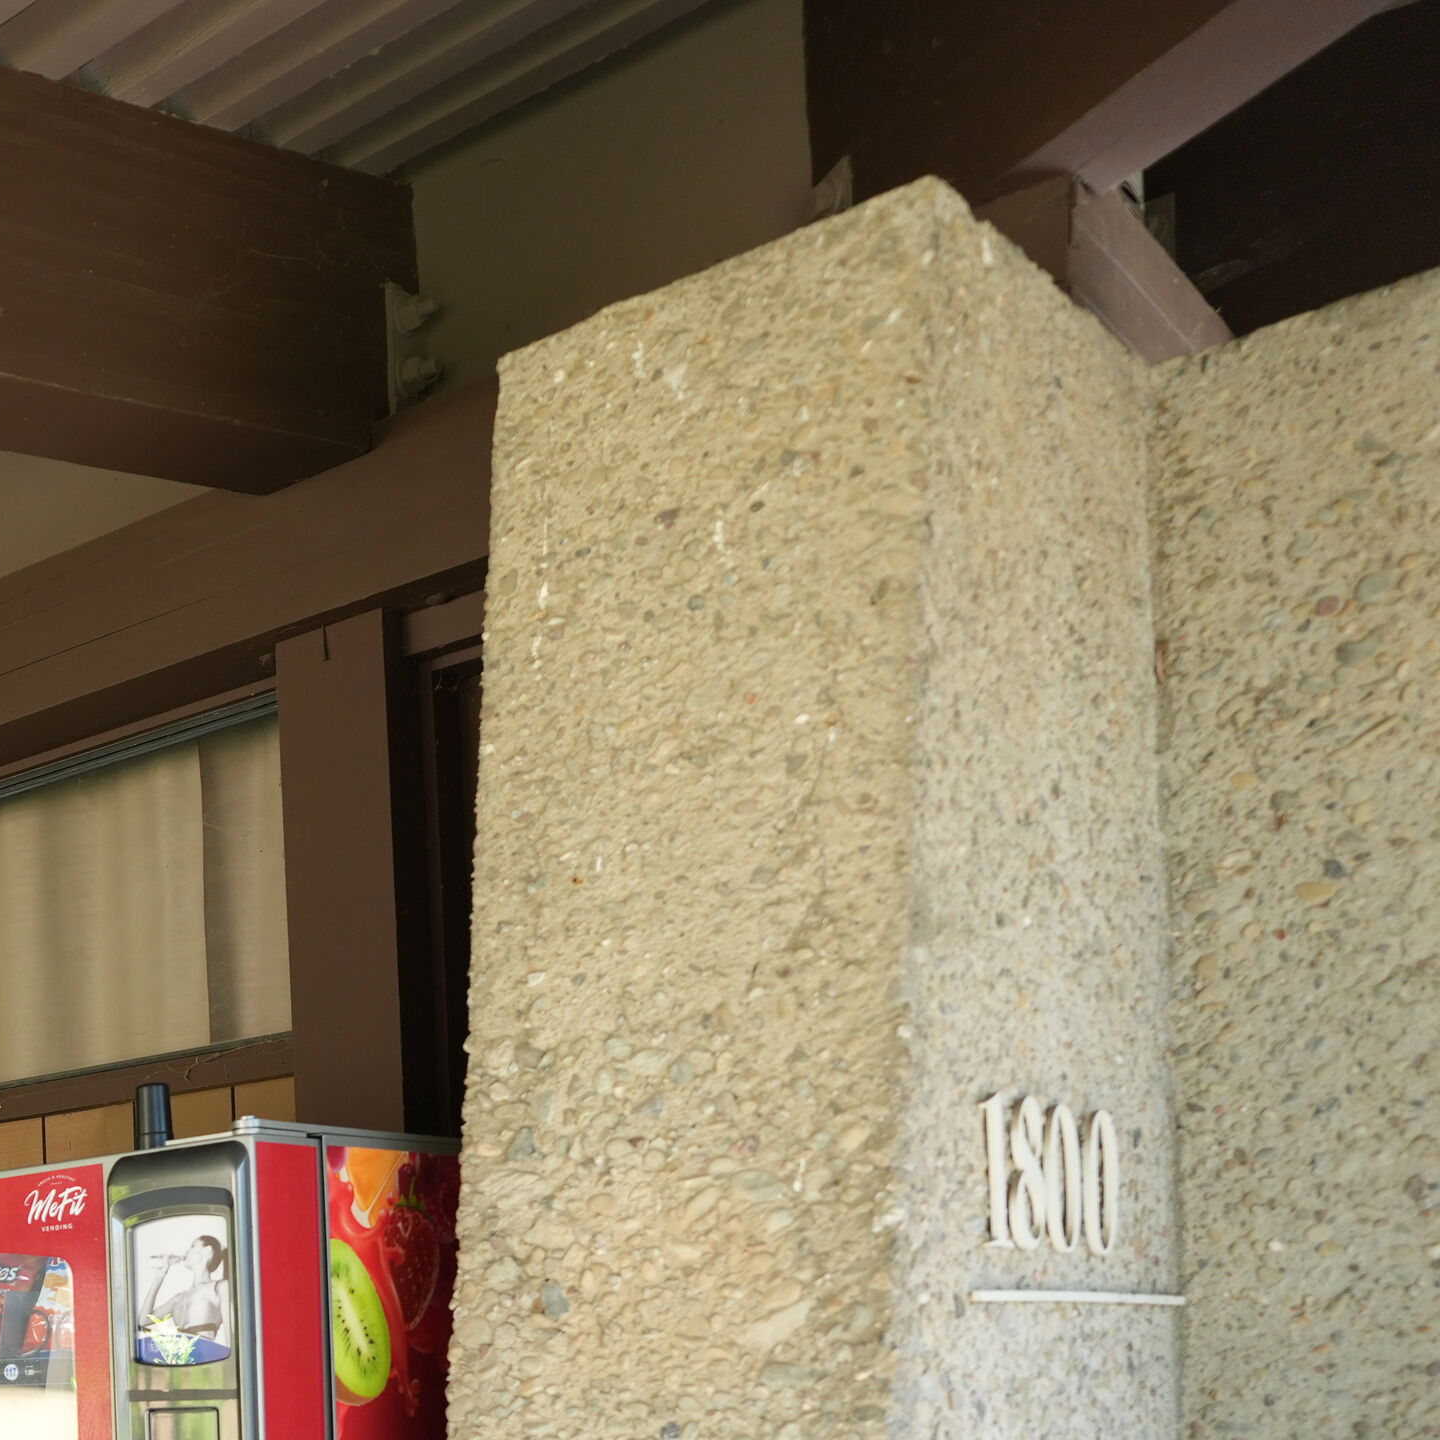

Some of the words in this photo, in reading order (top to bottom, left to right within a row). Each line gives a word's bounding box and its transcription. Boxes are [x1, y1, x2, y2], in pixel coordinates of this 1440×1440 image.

[977, 1091, 1120, 1256] 1800
[24, 1185, 88, 1225] MeFit
[41, 1223, 73, 1232] VENDING
[4, 1368, 17, 1378] 117
